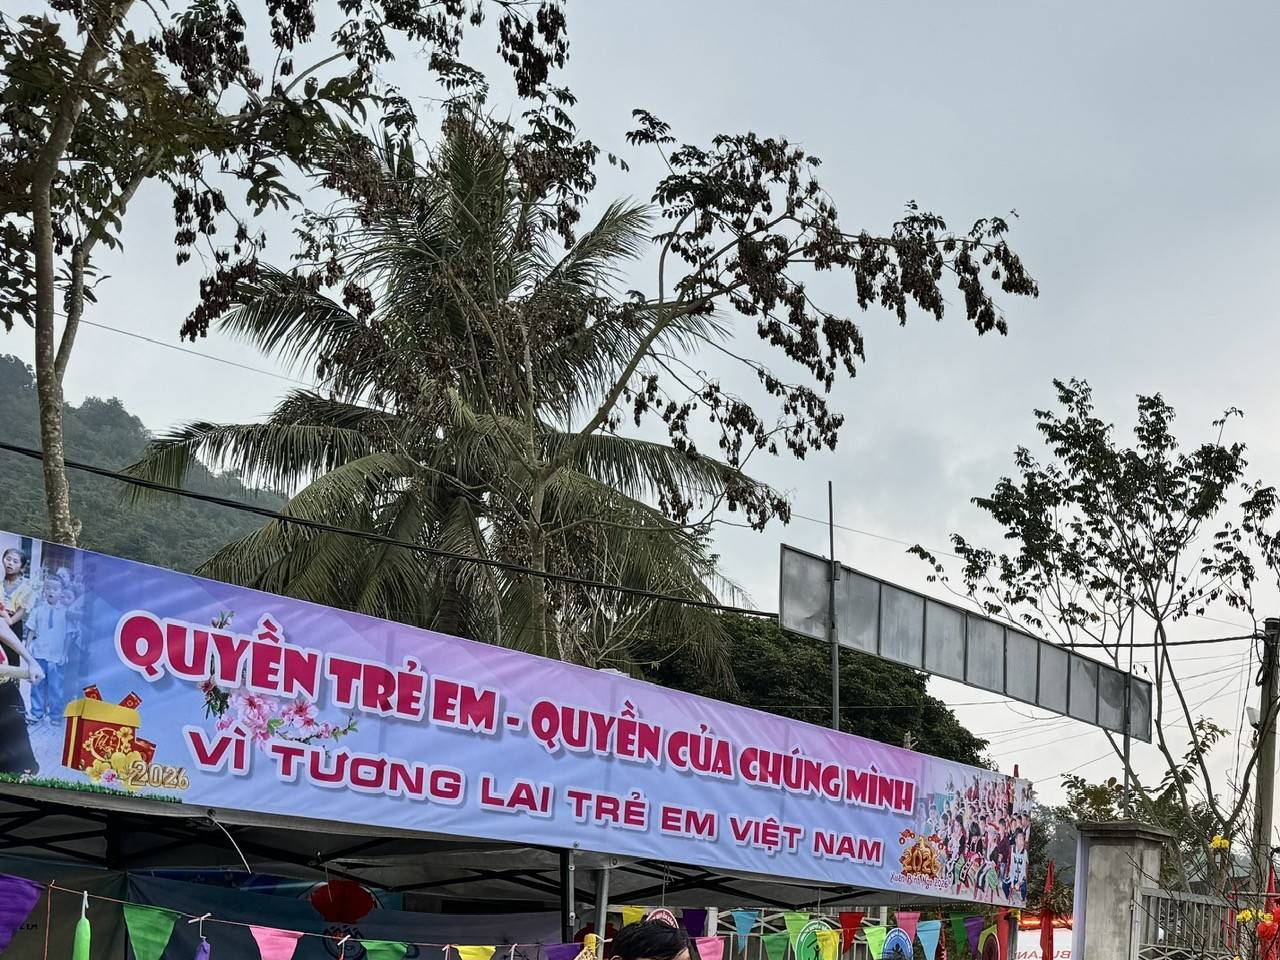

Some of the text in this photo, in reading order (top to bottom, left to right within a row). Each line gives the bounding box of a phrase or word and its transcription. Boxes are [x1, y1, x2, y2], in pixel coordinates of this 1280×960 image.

[120, 616, 318, 697] QUYỀN
[329, 658, 424, 716] TRẺ
[433, 679, 496, 730] EM
[531, 700, 661, 762] QUYỀN
[667, 724, 732, 776] CỦA
[739, 747, 840, 798] CHÚNG
[846, 765, 914, 812] MÌNH
[130, 761, 189, 790] 2026
[189, 727, 882, 862] VÌ TƯƠNG LAI TRẺ EM VIỆT NAM
[900, 848, 941, 874] 2026
